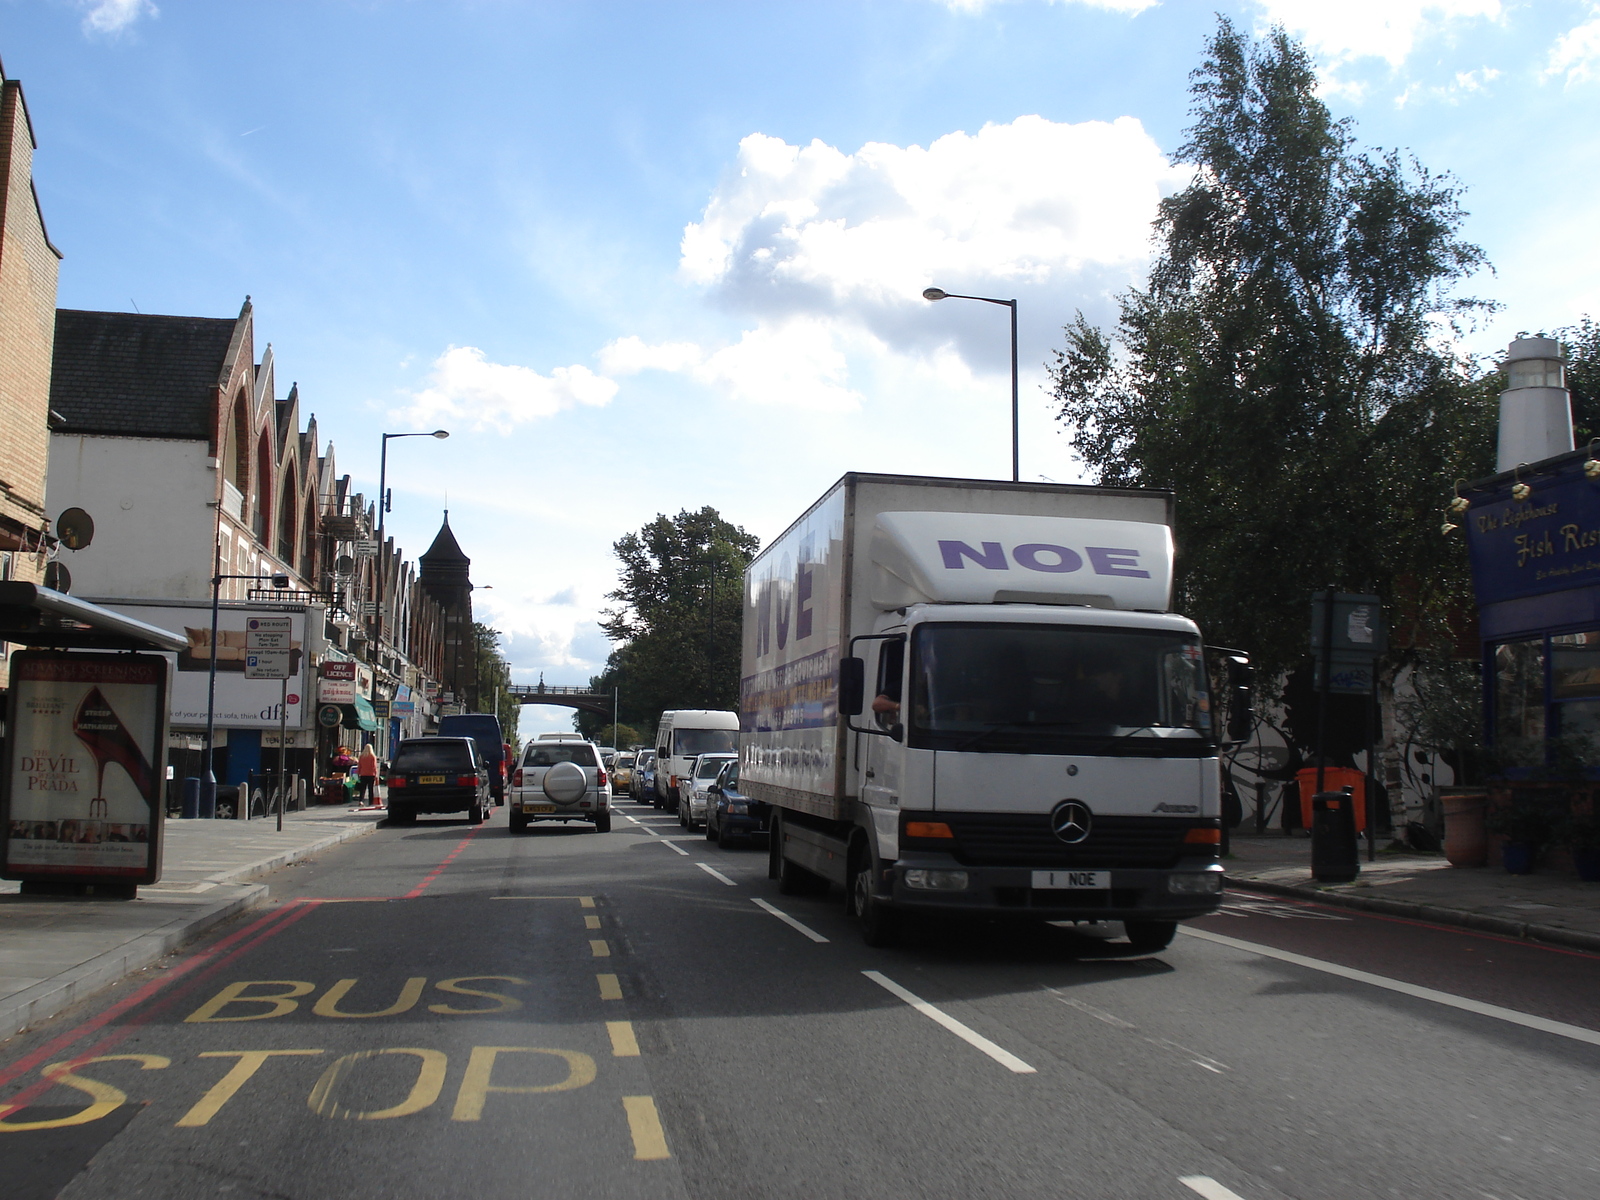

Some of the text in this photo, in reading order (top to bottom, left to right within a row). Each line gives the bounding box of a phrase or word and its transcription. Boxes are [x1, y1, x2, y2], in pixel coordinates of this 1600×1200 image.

[1477, 503, 1558, 533] The Lighthouse
[1514, 530, 1554, 567] Fish
[938, 540, 1150, 578] NOE
[24, 663, 153, 676] ADVANCE SCREENINGS
[326, 670, 353, 678] LICENCE
[224, 712, 239, 720] sofa,
[77, 723, 118, 731] HATHAWAY
[33, 749, 48, 757] THE
[21, 753, 80, 773] DEVIL
[28, 776, 78, 791] PRADA
[1068, 872, 1096, 886] NOE
[182, 975, 530, 1023] BUS
[0, 1046, 597, 1132] STOP
